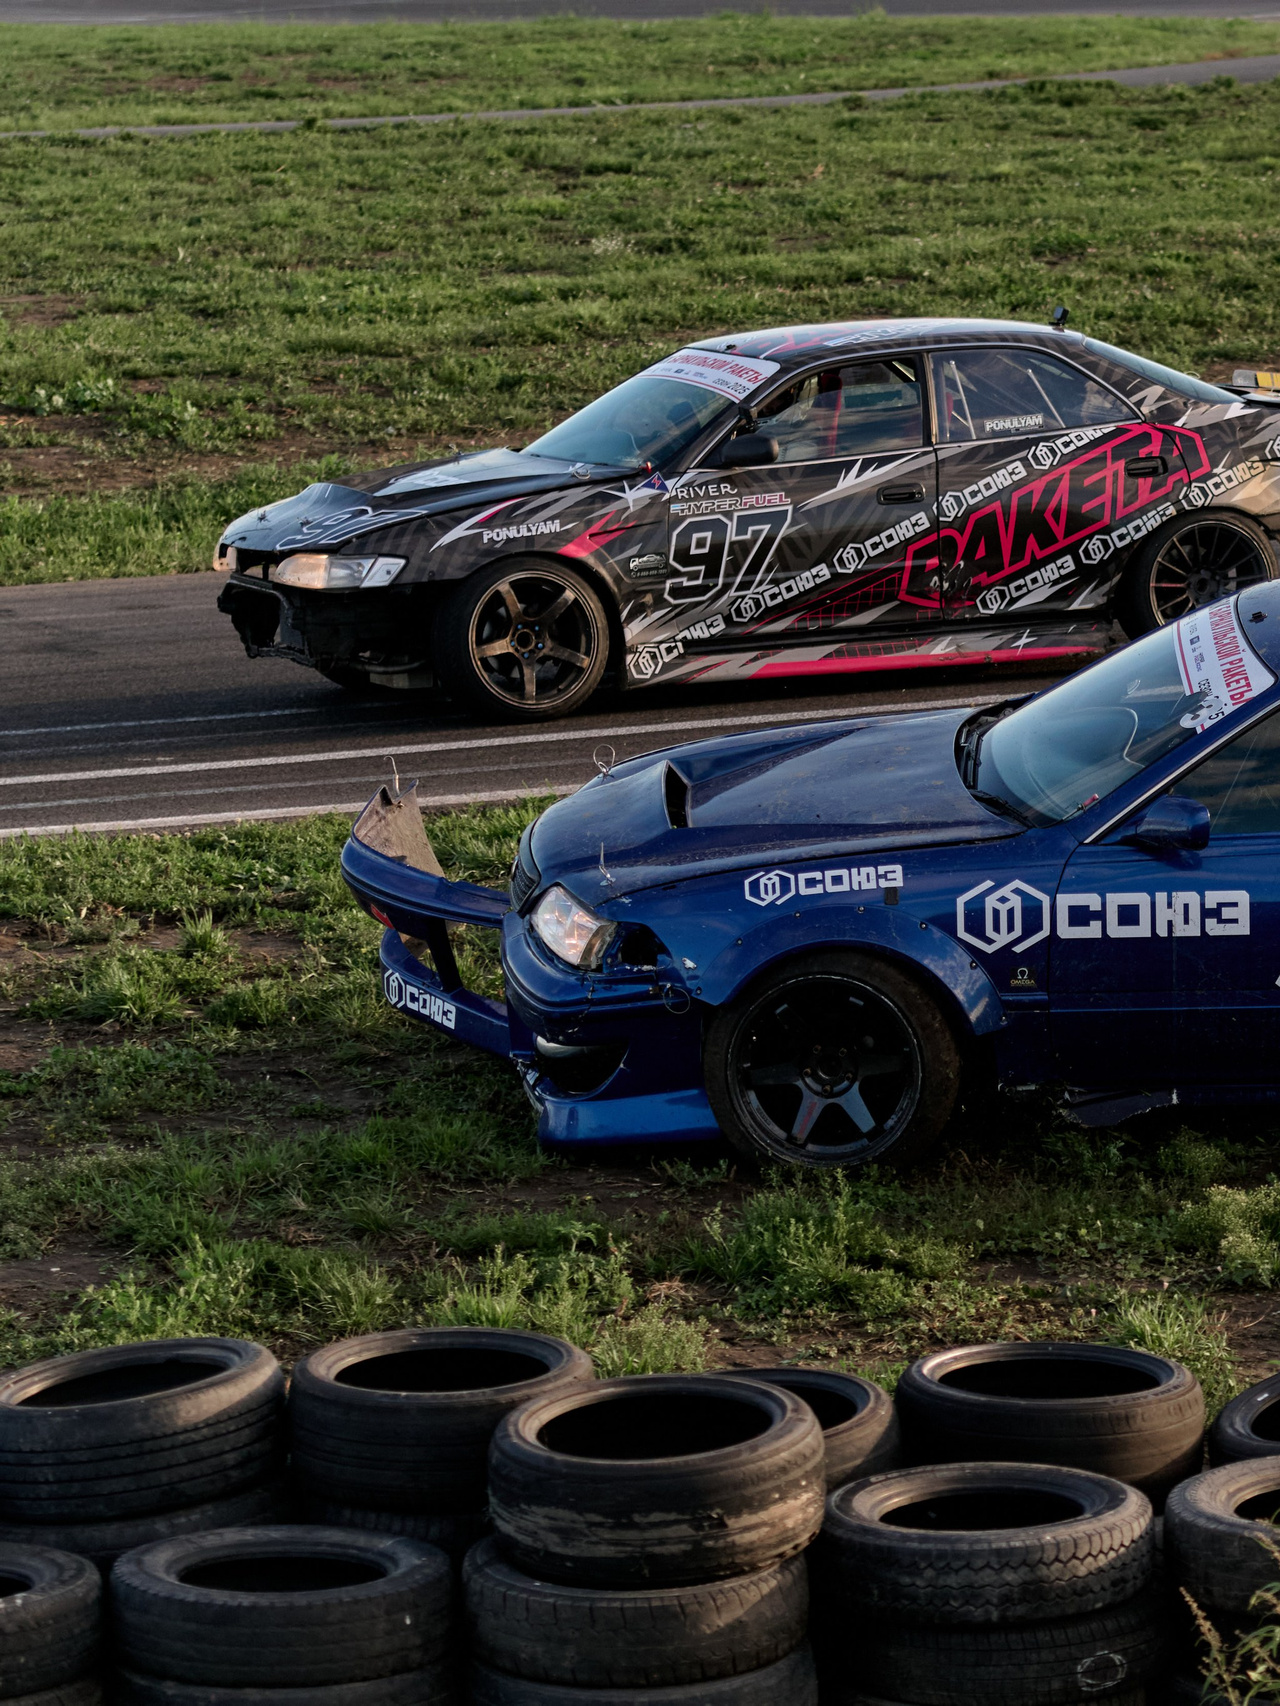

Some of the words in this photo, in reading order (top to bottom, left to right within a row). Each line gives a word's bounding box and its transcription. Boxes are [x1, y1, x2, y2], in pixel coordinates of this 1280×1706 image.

[722, 363, 768, 385] РАКЕТЫ
[727, 382, 750, 395] 2025
[984, 414, 1044, 433] PONULYAM
[677, 483, 737, 500] RIVER
[963, 460, 1027, 506] СОЮЗ
[1206, 456, 1266, 497] СОЮЗ
[276, 506, 429, 550] 97
[482, 519, 560, 544] PONULYAM
[865, 511, 931, 557] СОЮЗ
[1111, 502, 1177, 548] СОЮЗ
[664, 505, 793, 604] 97
[1010, 555, 1076, 598] СОЮЗ
[762, 563, 831, 607] СОЮЗ
[1220, 657, 1255, 706] РАКЕТЫ
[798, 864, 904, 896] СОЮЗ
[1056, 889, 1251, 939] СОЮЗ
[406, 984, 456, 1030] СОЮЗ
